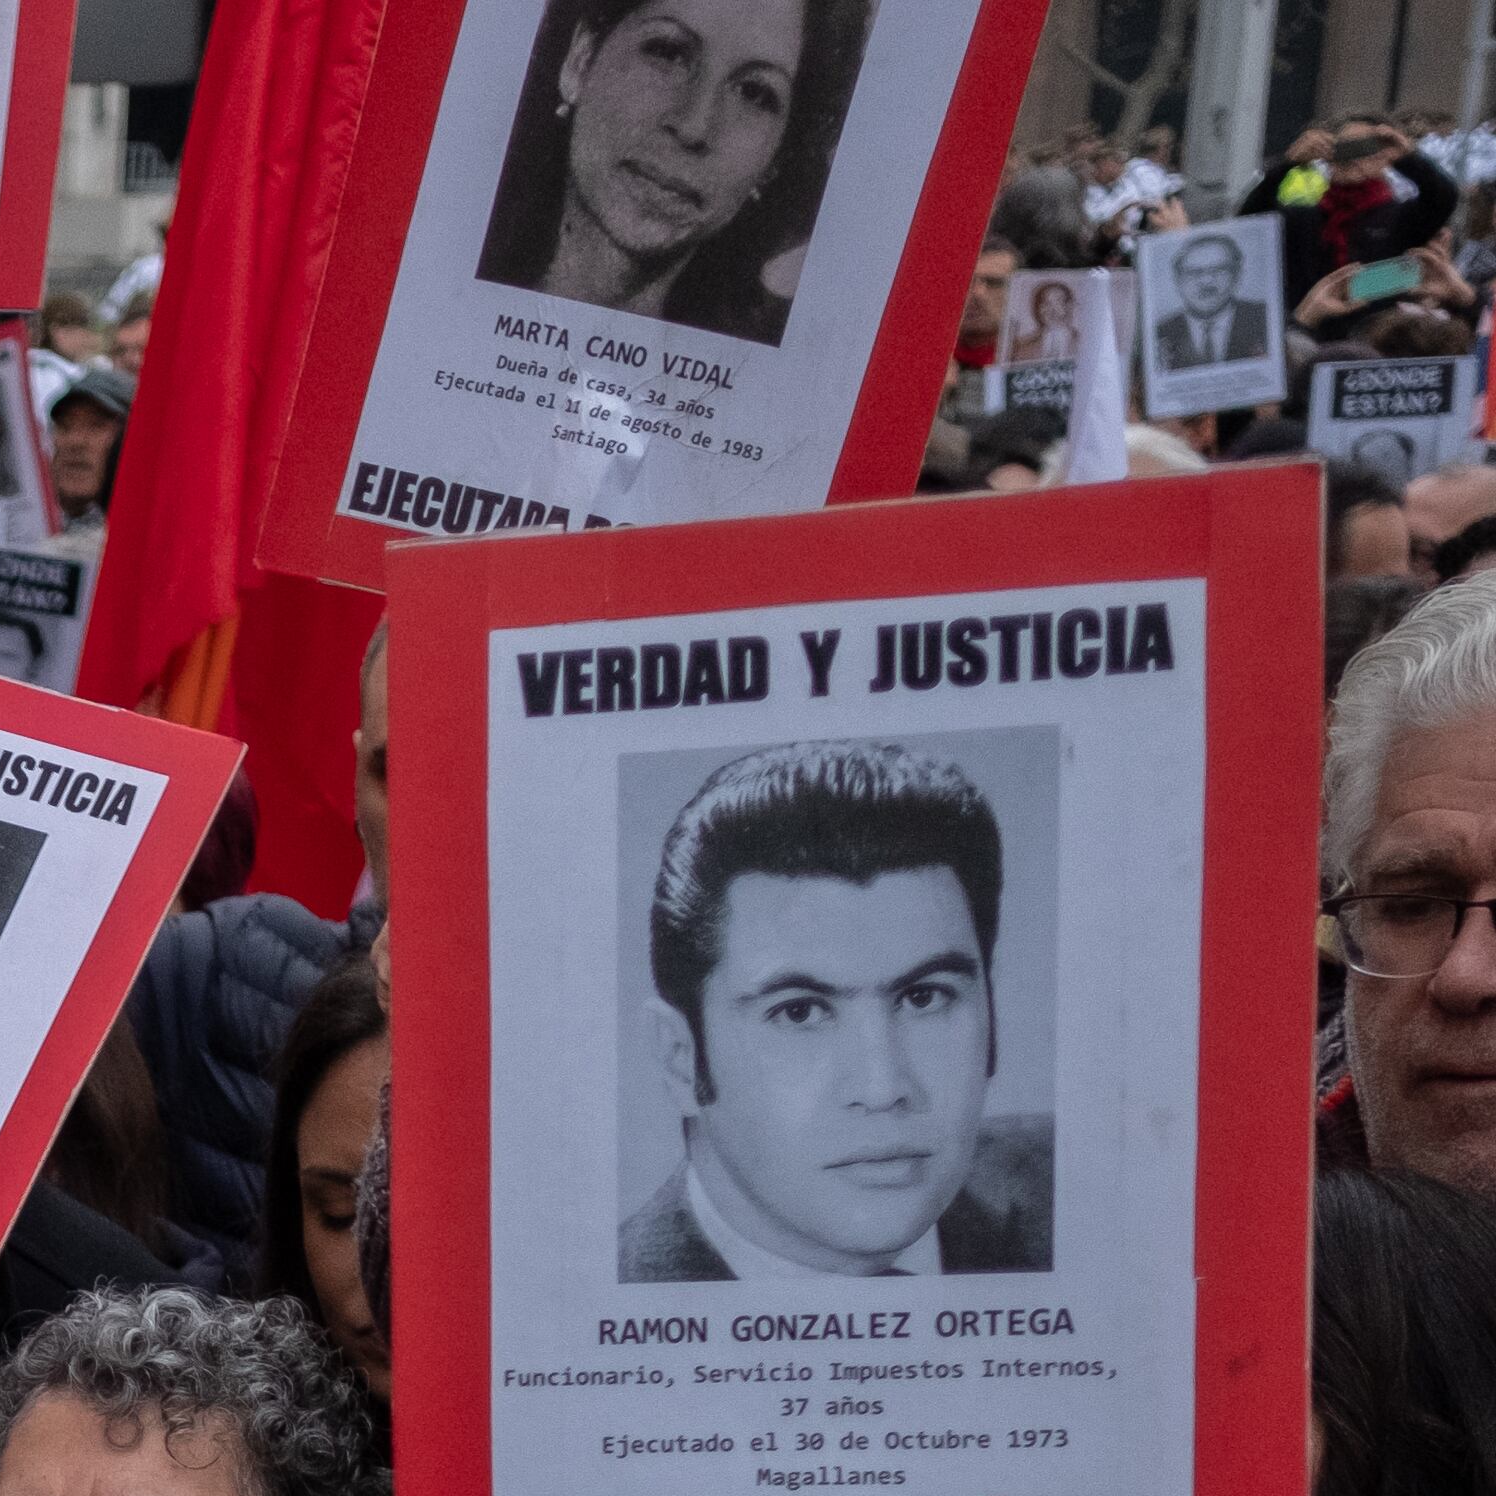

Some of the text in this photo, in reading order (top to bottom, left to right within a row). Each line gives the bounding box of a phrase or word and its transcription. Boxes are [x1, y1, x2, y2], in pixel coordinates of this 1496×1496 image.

[494, 313, 735, 391] MARTA CANO VIDAL
[495, 354, 716, 421] Dueña de casa, 34 años
[434, 369, 527, 405] Ejecutada
[536, 391, 556, 410] el
[588, 403, 612, 422] de
[621, 410, 682, 442] agosto
[690, 427, 713, 449] de
[721, 437, 764, 462] 1983
[551, 422, 628, 457] Santiago
[516, 602, 1176, 718] VERDAD Y JUSTICIA
[597, 1307, 1075, 1346] RAMON GONZALEZ ORTEGA
[503, 1355, 1119, 1391] Funcionario, Servicio Impuestos Internos,
[779, 1393, 884, 1418] 37 años
[601, 1426, 1070, 1459] Ejecutado el 30 de Octubre 1973
[755, 1465, 907, 1490] Magallanes
